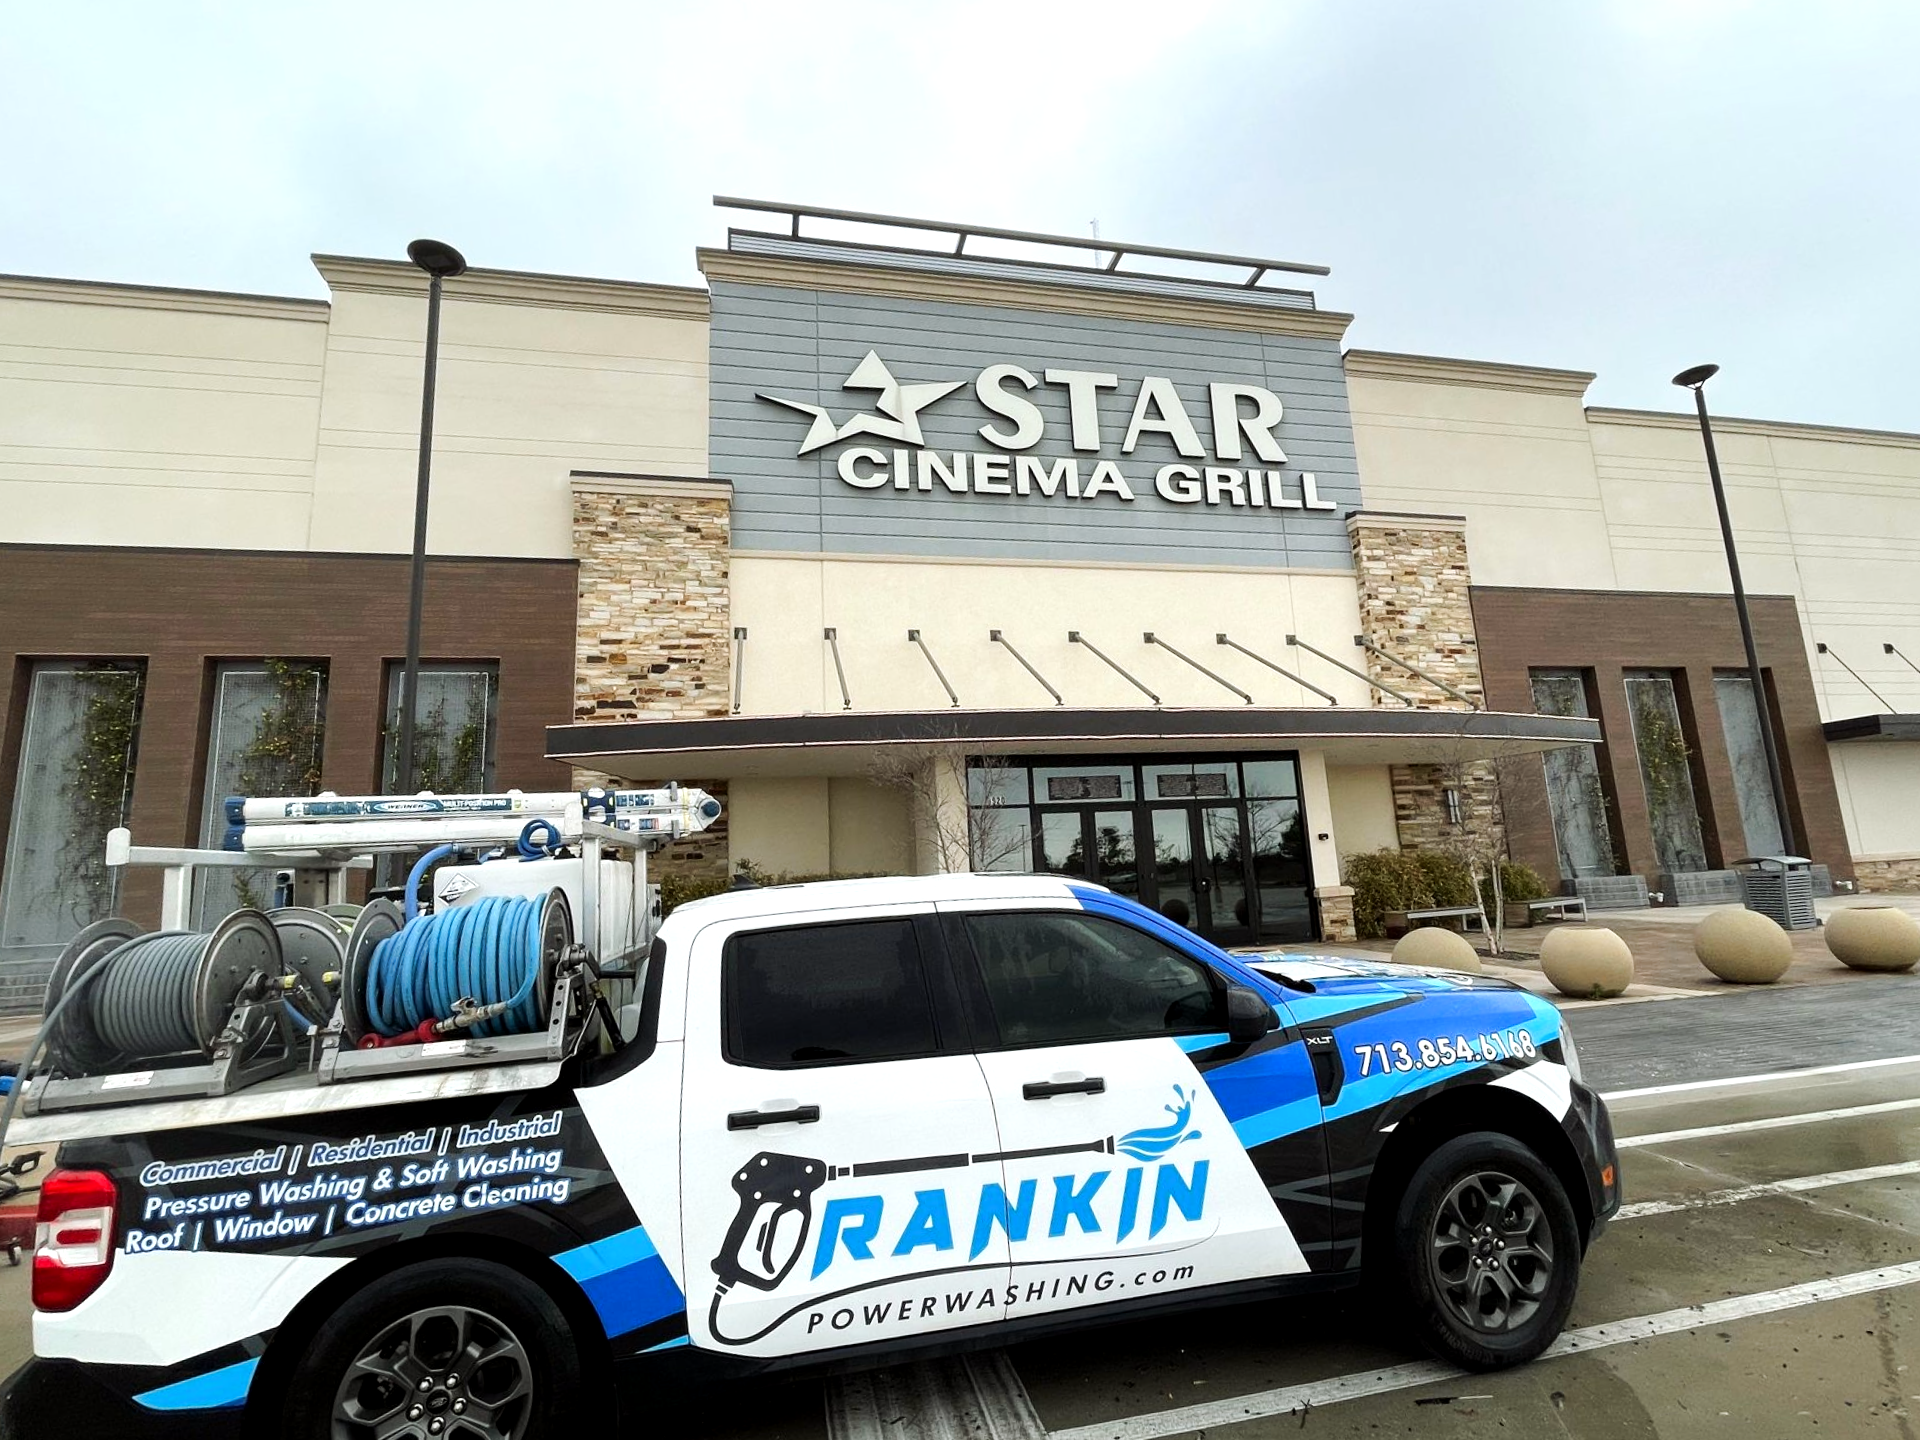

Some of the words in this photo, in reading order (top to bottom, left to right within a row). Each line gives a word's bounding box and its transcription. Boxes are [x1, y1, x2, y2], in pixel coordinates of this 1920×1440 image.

[975, 364, 1288, 463] STAR
[836, 446, 1134, 500] CINEMA
[1154, 463, 1337, 510] GRILL
[1306, 1035, 1333, 1046] XLT
[1354, 1029, 1537, 1077] 713.854.6168
[139, 1150, 285, 1187] Commercial
[308, 1127, 436, 1166] Residential
[456, 1110, 563, 1149] Industrial
[143, 1190, 250, 1221] Pressure
[258, 1173, 366, 1206] Washing
[372, 1167, 393, 1190] &
[399, 1161, 451, 1187] Soft
[456, 1148, 562, 1180] Washing
[124, 1225, 185, 1254] Roof
[214, 1213, 316, 1243] Window
[345, 1192, 456, 1225] Concrete
[462, 1178, 570, 1209] Cleaning
[810, 1159, 1211, 1281] RANKIN
[806, 1262, 1195, 1334] POWERWASHING.com
